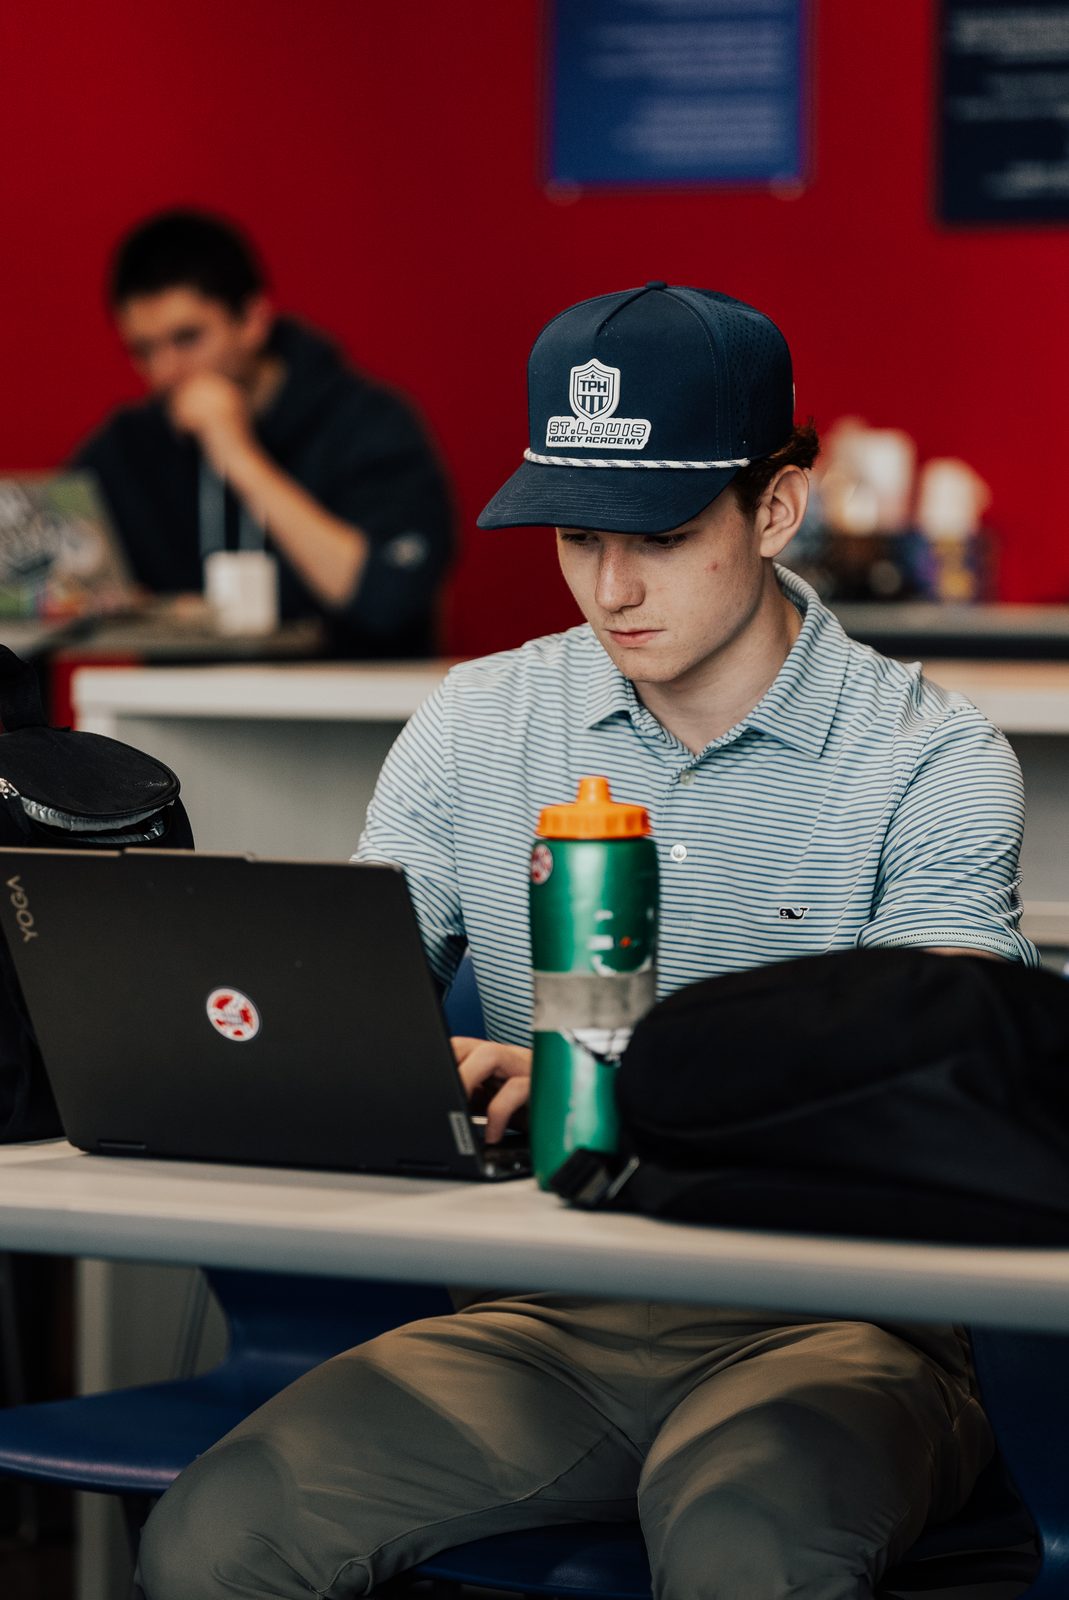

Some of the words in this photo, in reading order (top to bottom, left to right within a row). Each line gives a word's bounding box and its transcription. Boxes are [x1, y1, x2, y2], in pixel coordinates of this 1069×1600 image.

[579, 380, 607, 392] TPH
[548, 435, 583, 443] HOCKEY
[585, 436, 644, 445] ACADEMY
[6, 875, 38, 943] YOGA
